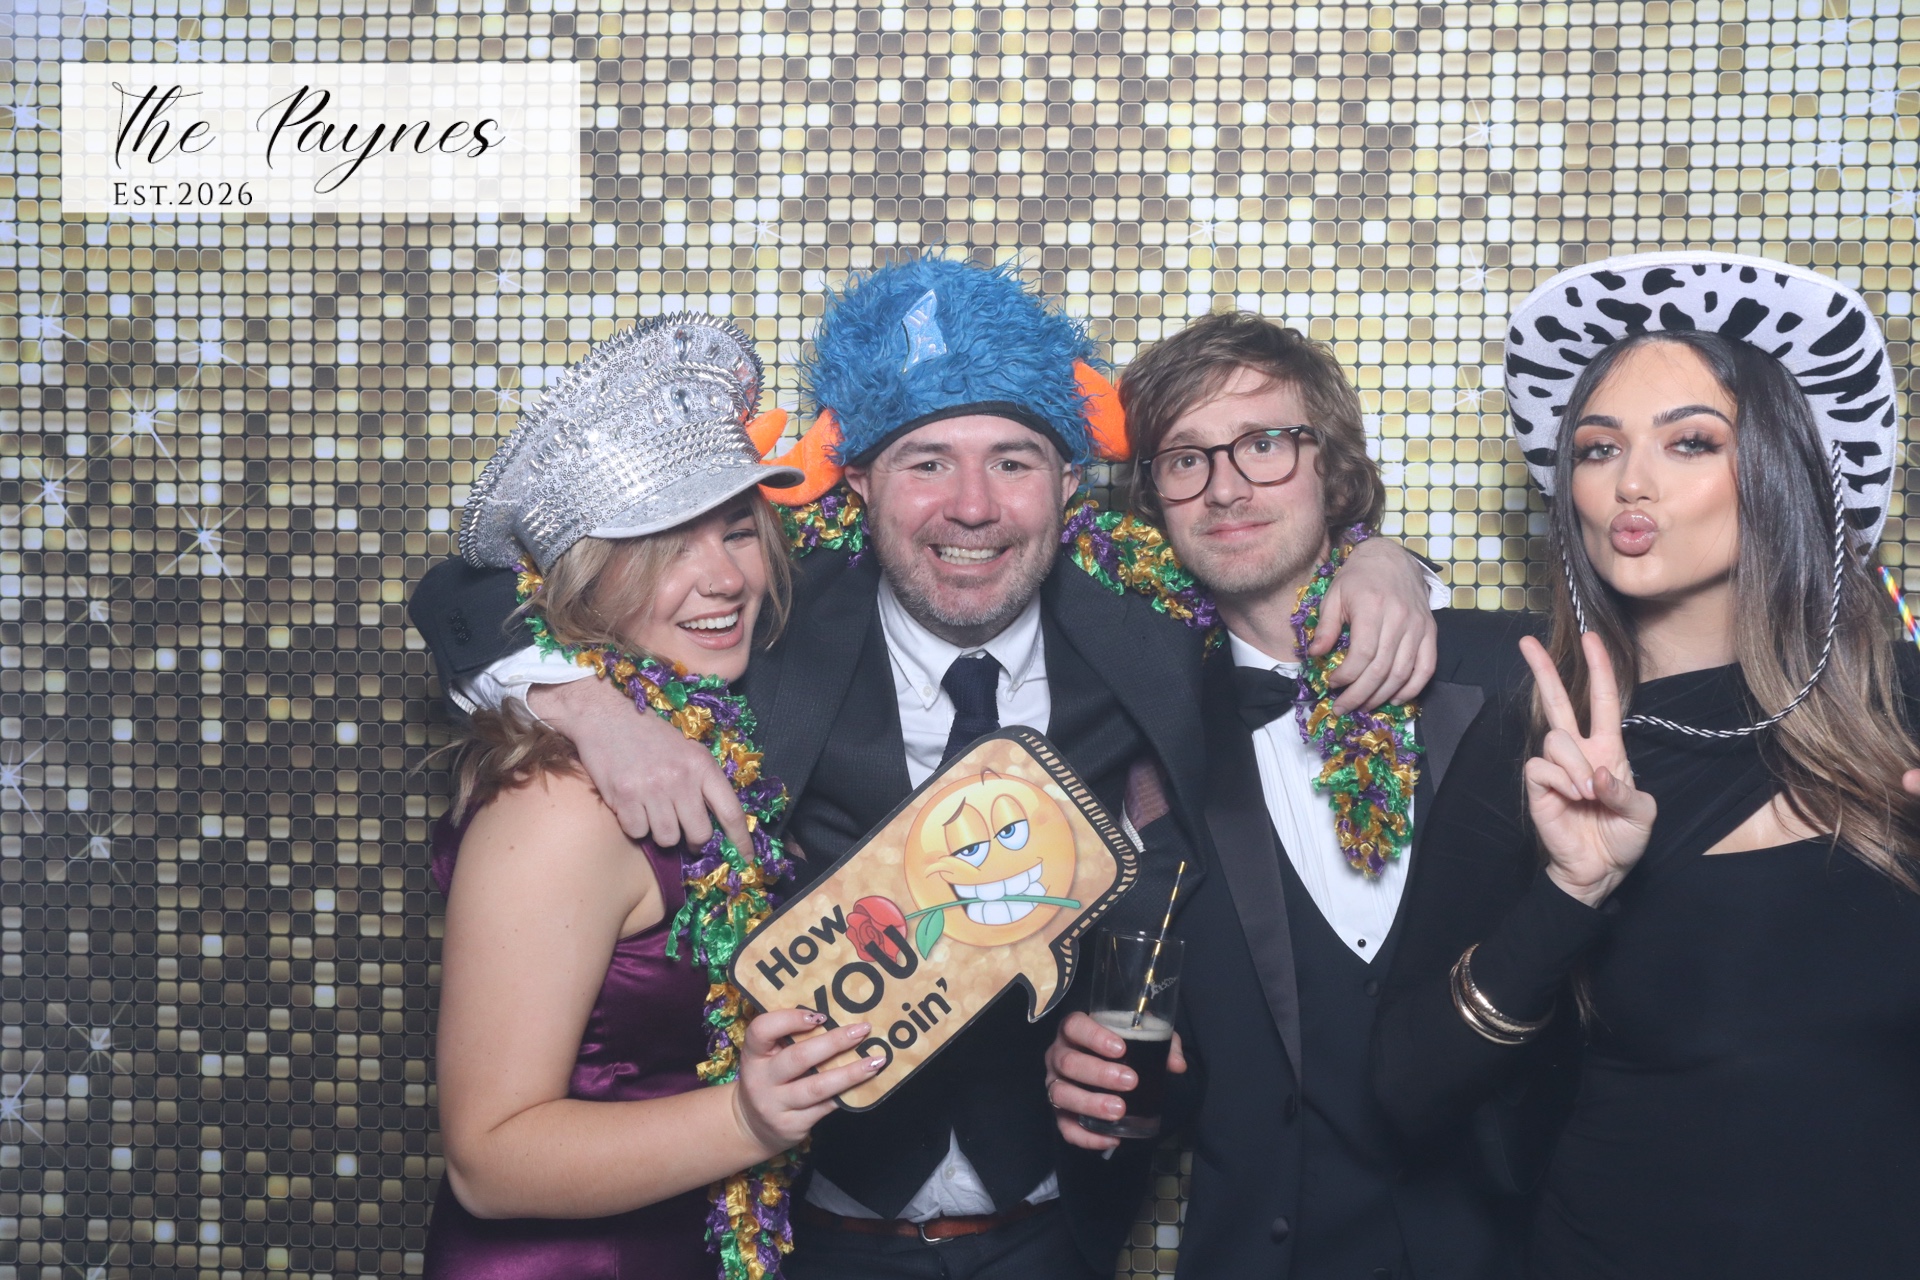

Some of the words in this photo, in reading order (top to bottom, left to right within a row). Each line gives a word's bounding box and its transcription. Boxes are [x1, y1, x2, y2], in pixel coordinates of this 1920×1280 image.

[755, 904, 848, 991] How
[796, 924, 919, 1032] YOU
[855, 977, 952, 1076] Doin'
